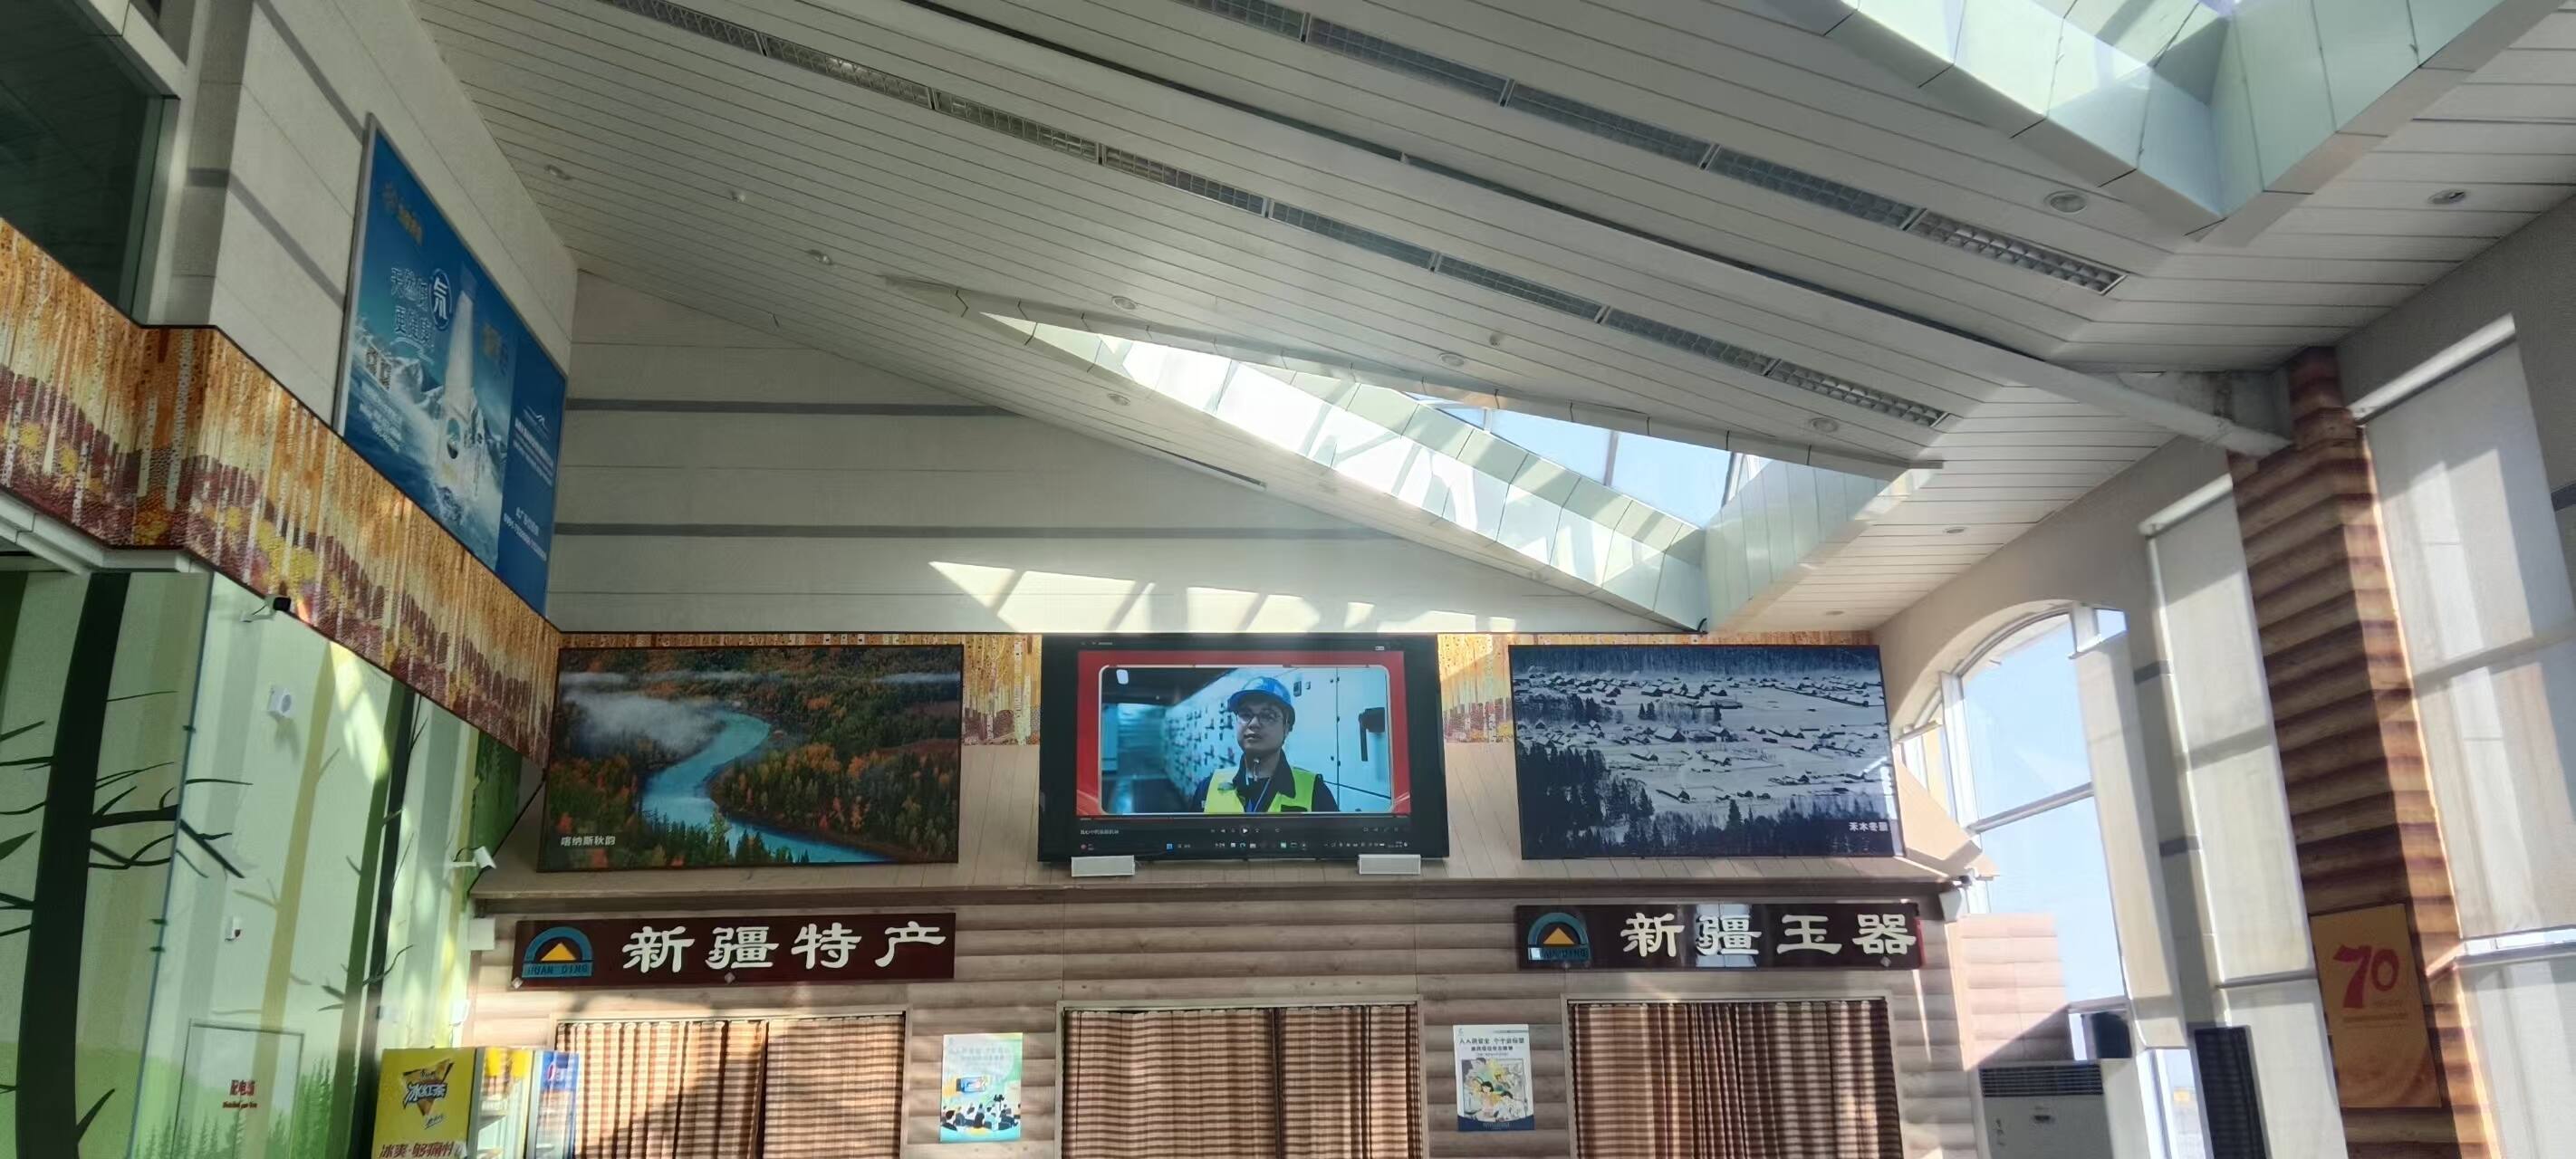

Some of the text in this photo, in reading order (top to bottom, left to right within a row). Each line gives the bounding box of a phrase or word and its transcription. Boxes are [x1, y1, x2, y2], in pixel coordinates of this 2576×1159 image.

[621, 920, 947, 973] 新疆特产
[1620, 912, 1917, 957] 新疆玉器
[2332, 944, 2400, 1010] 70
